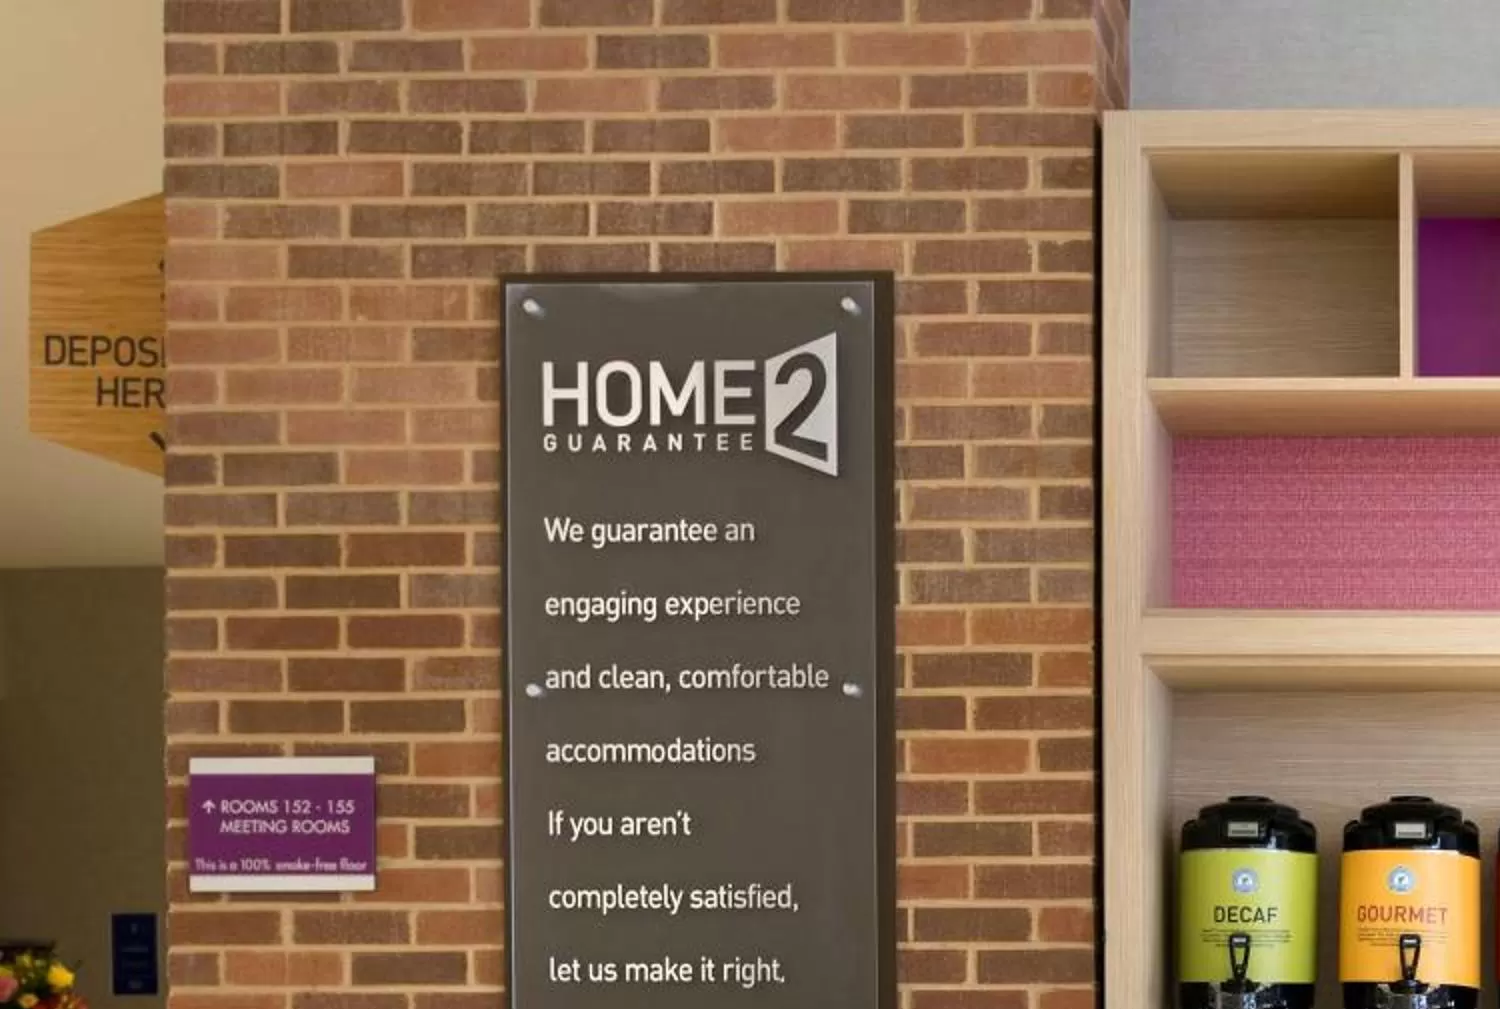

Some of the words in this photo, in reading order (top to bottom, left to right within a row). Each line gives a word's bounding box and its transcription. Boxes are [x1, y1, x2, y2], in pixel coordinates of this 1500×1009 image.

[543, 433, 753, 452] GUARANTEE
[544, 517, 584, 543] We
[591, 518, 717, 549] guarantee
[725, 522, 755, 542] an
[545, 590, 657, 622] engaging
[665, 590, 801, 622] experience
[545, 664, 591, 690] and
[598, 664, 671, 692] clean,
[679, 663, 830, 689] comfortable
[546, 737, 757, 763] accommodations
[220, 799, 278, 814] ROOMS
[284, 799, 311, 814] 152
[327, 799, 355, 814] 155
[219, 819, 288, 834] MEETING
[292, 819, 350, 834] ROOMS
[549, 810, 564, 836] If
[569, 816, 613, 842] you
[620, 810, 692, 836] aren't
[195, 857, 216, 871] This
[217, 859, 226, 871] is
[240, 857, 271, 871] 100%
[275, 856, 337, 871] smoke-free
[339, 856, 367, 871] floor
[549, 883, 684, 915] completely
[690, 883, 799, 912] satisfied,
[1213, 905, 1279, 923] DECAF
[1357, 905, 1448, 925] GOURMET
[549, 956, 581, 982] let
[588, 962, 618, 982] us
[625, 956, 693, 982] make
[700, 956, 715, 982] it
